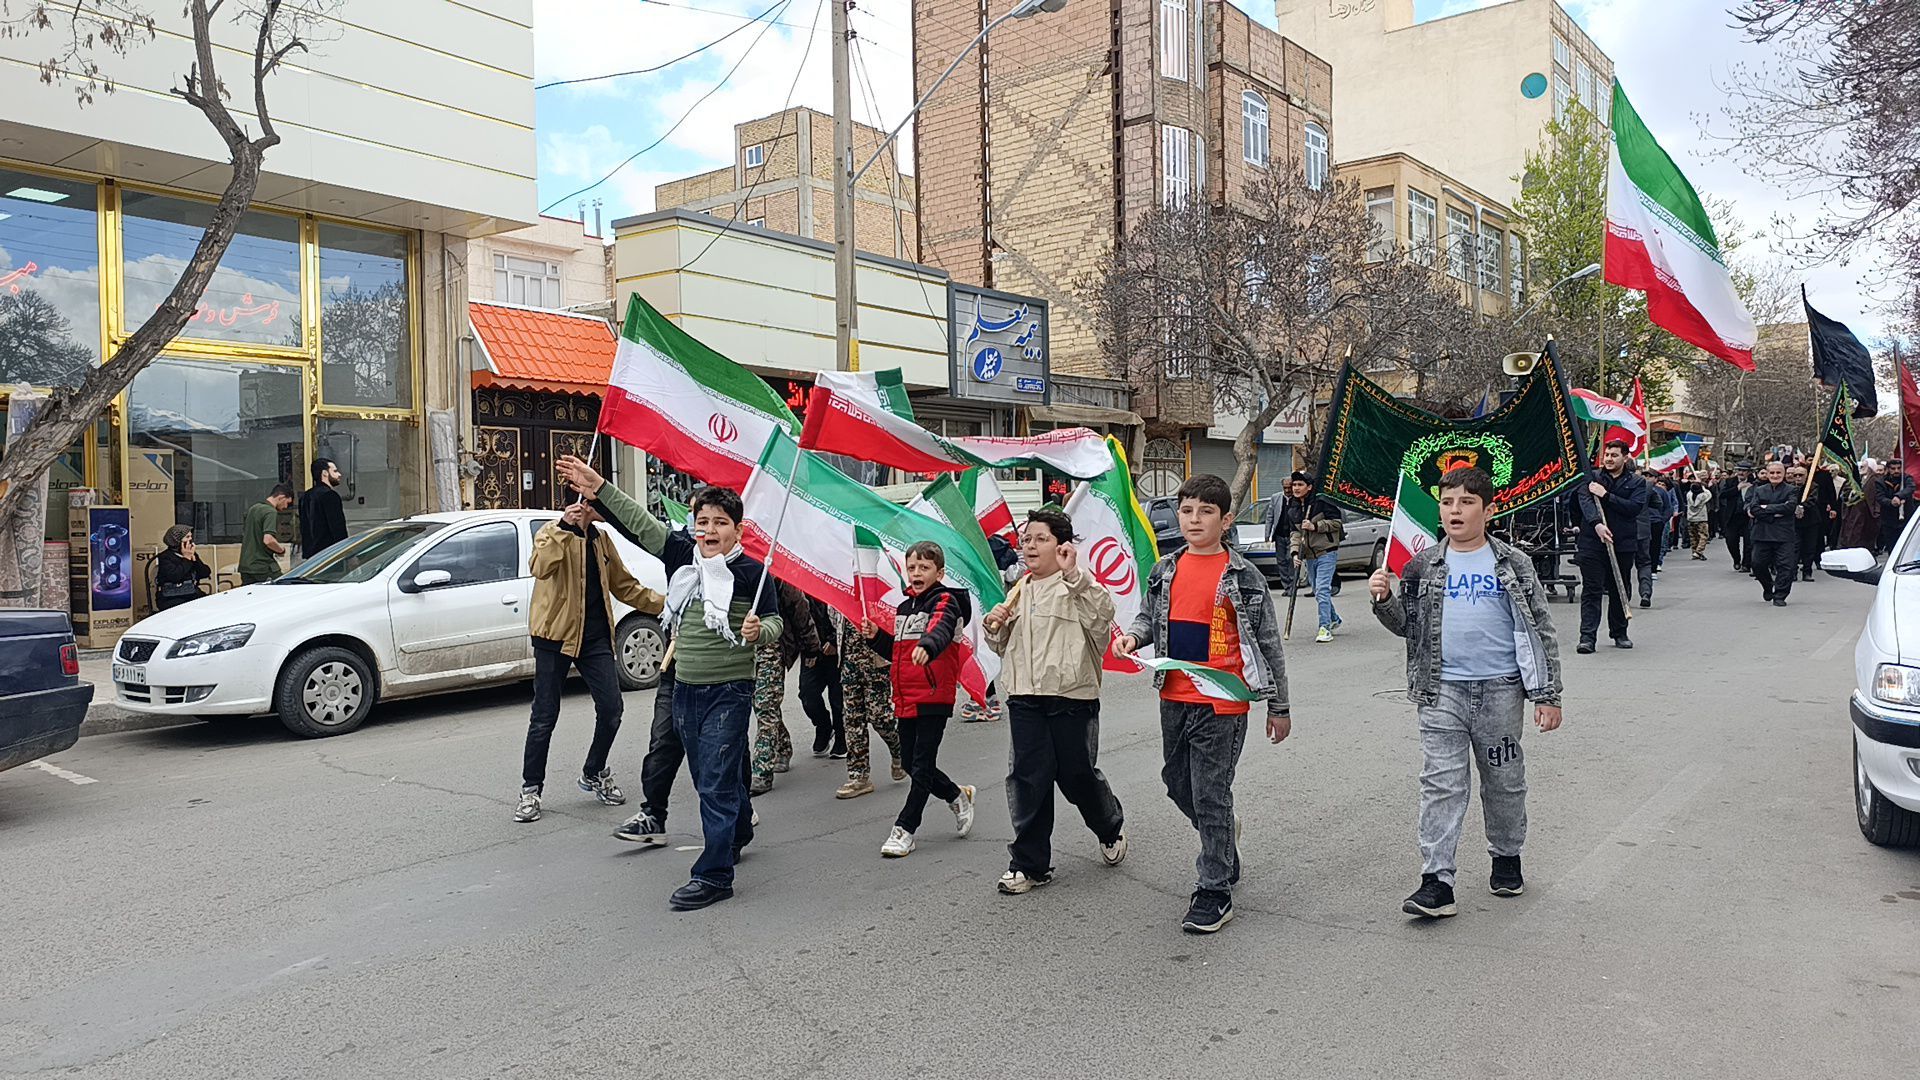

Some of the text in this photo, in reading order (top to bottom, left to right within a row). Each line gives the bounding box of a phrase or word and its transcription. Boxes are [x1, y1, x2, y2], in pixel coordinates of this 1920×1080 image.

[964, 294, 1029, 398] معلم
[1014, 320, 1042, 360] بیمه
[1443, 573, 1506, 592] LAPSE
